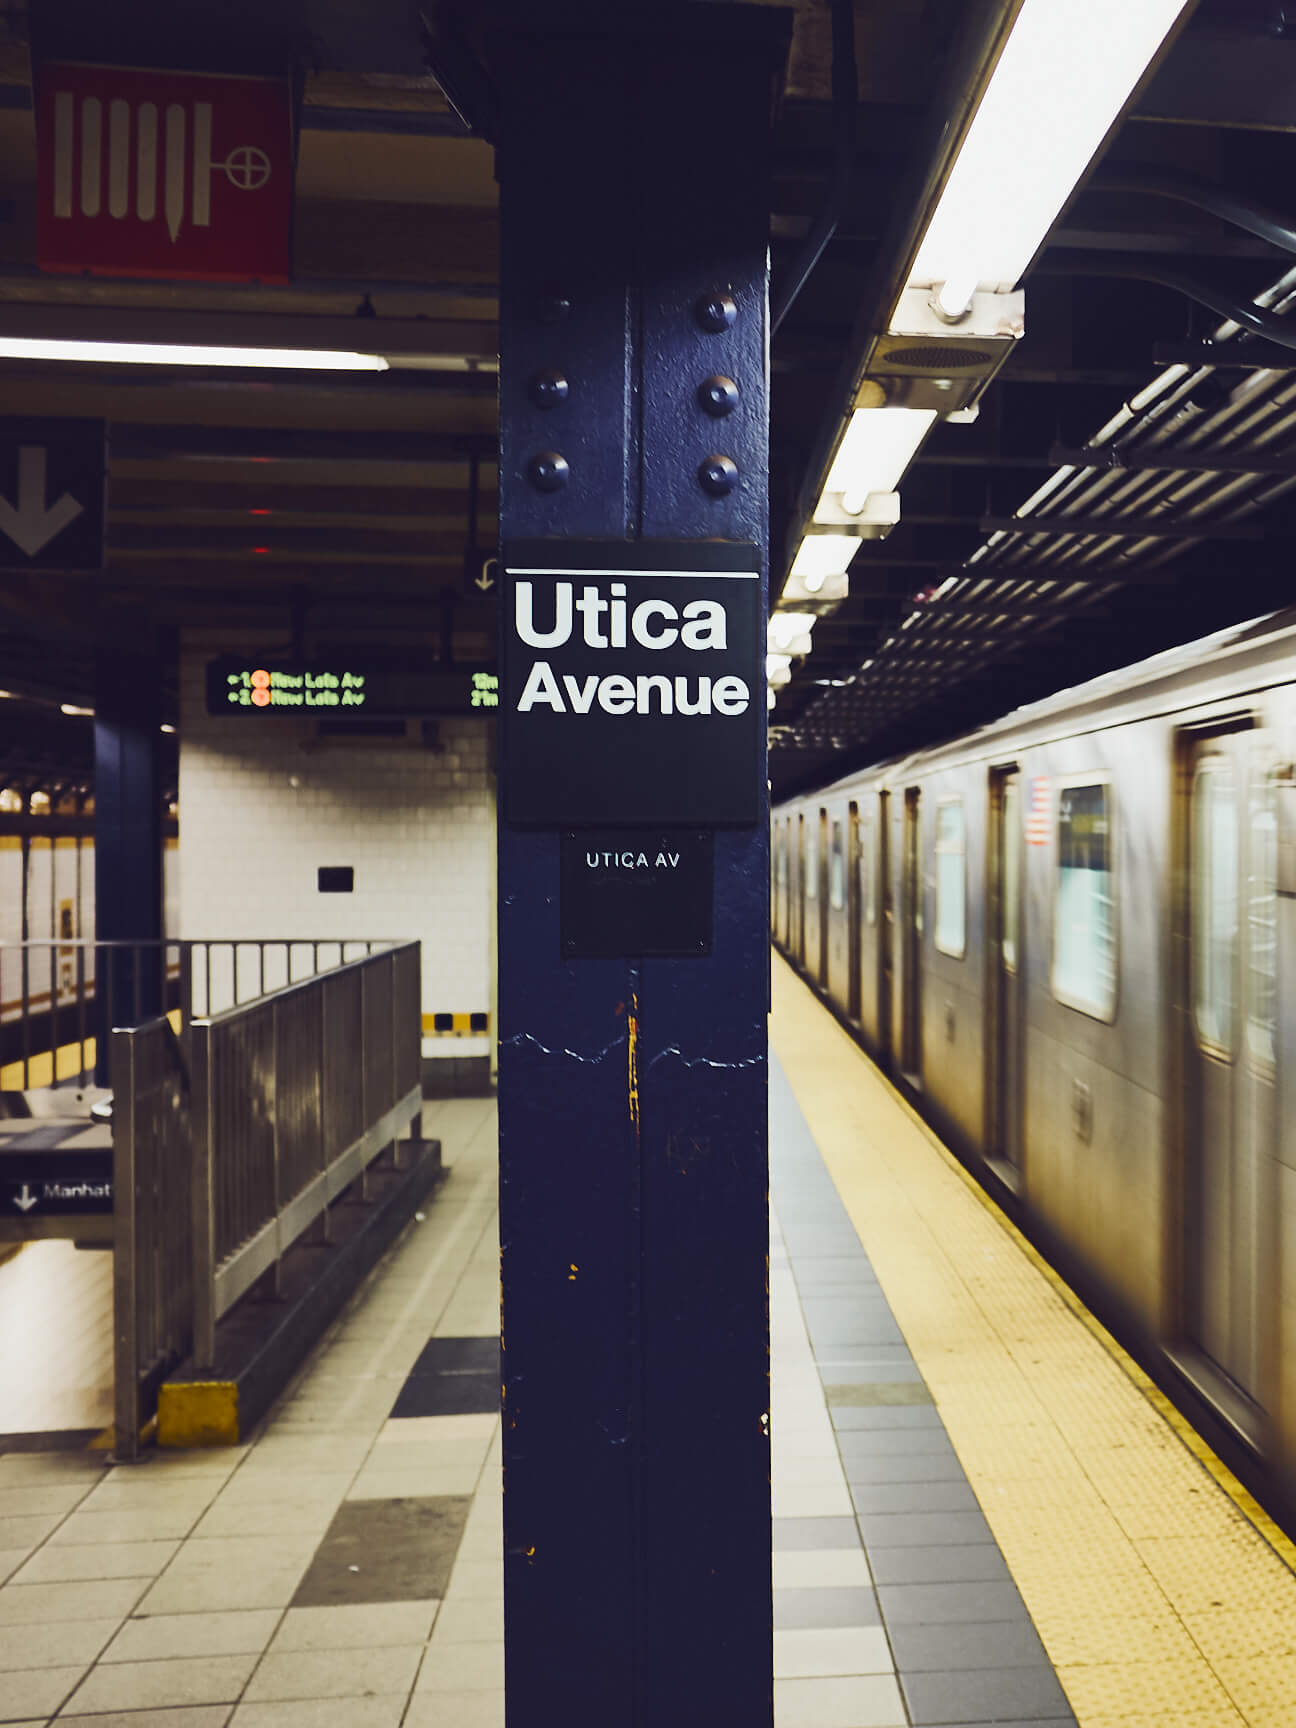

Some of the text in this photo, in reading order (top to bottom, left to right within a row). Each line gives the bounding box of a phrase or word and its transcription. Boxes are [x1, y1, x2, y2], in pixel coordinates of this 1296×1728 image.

[515, 581, 728, 651] Utica
[341, 671, 365, 689] Av
[517, 661, 750, 716] Avenue
[341, 689, 366, 706] Av
[586, 852, 681, 869] UTICA AV
